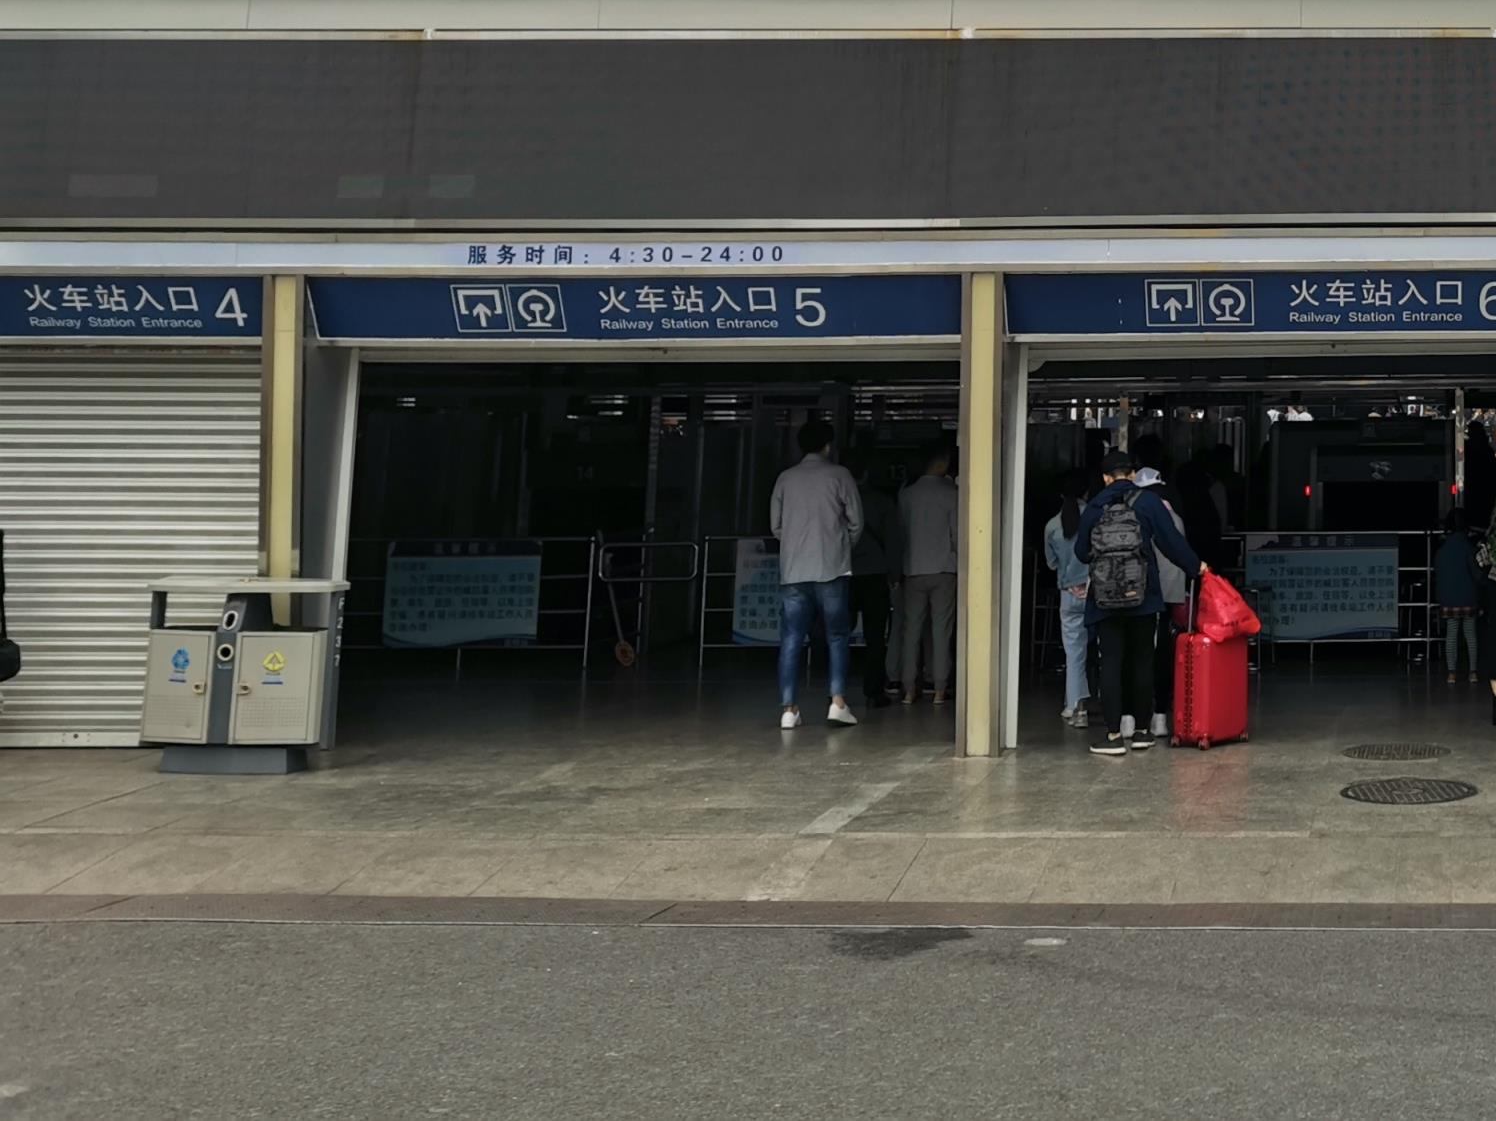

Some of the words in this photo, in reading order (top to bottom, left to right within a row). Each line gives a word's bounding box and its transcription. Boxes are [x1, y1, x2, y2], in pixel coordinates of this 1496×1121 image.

[1289, 279, 1463, 307] 火车站入口
[24, 284, 199, 312] 火车站入口
[215, 287, 248, 327] 4
[598, 284, 777, 314] 火车站入口
[795, 287, 826, 327] 5
[29, 316, 81, 329] Railway
[88, 316, 135, 328] Station
[142, 317, 202, 328] Entrance
[600, 318, 654, 331] Railway
[661, 318, 709, 329] Station
[716, 318, 778, 328] Entrance
[1289, 311, 1341, 324] Railway
[1348, 311, 1395, 322] Station
[1402, 311, 1463, 322] Entrance
